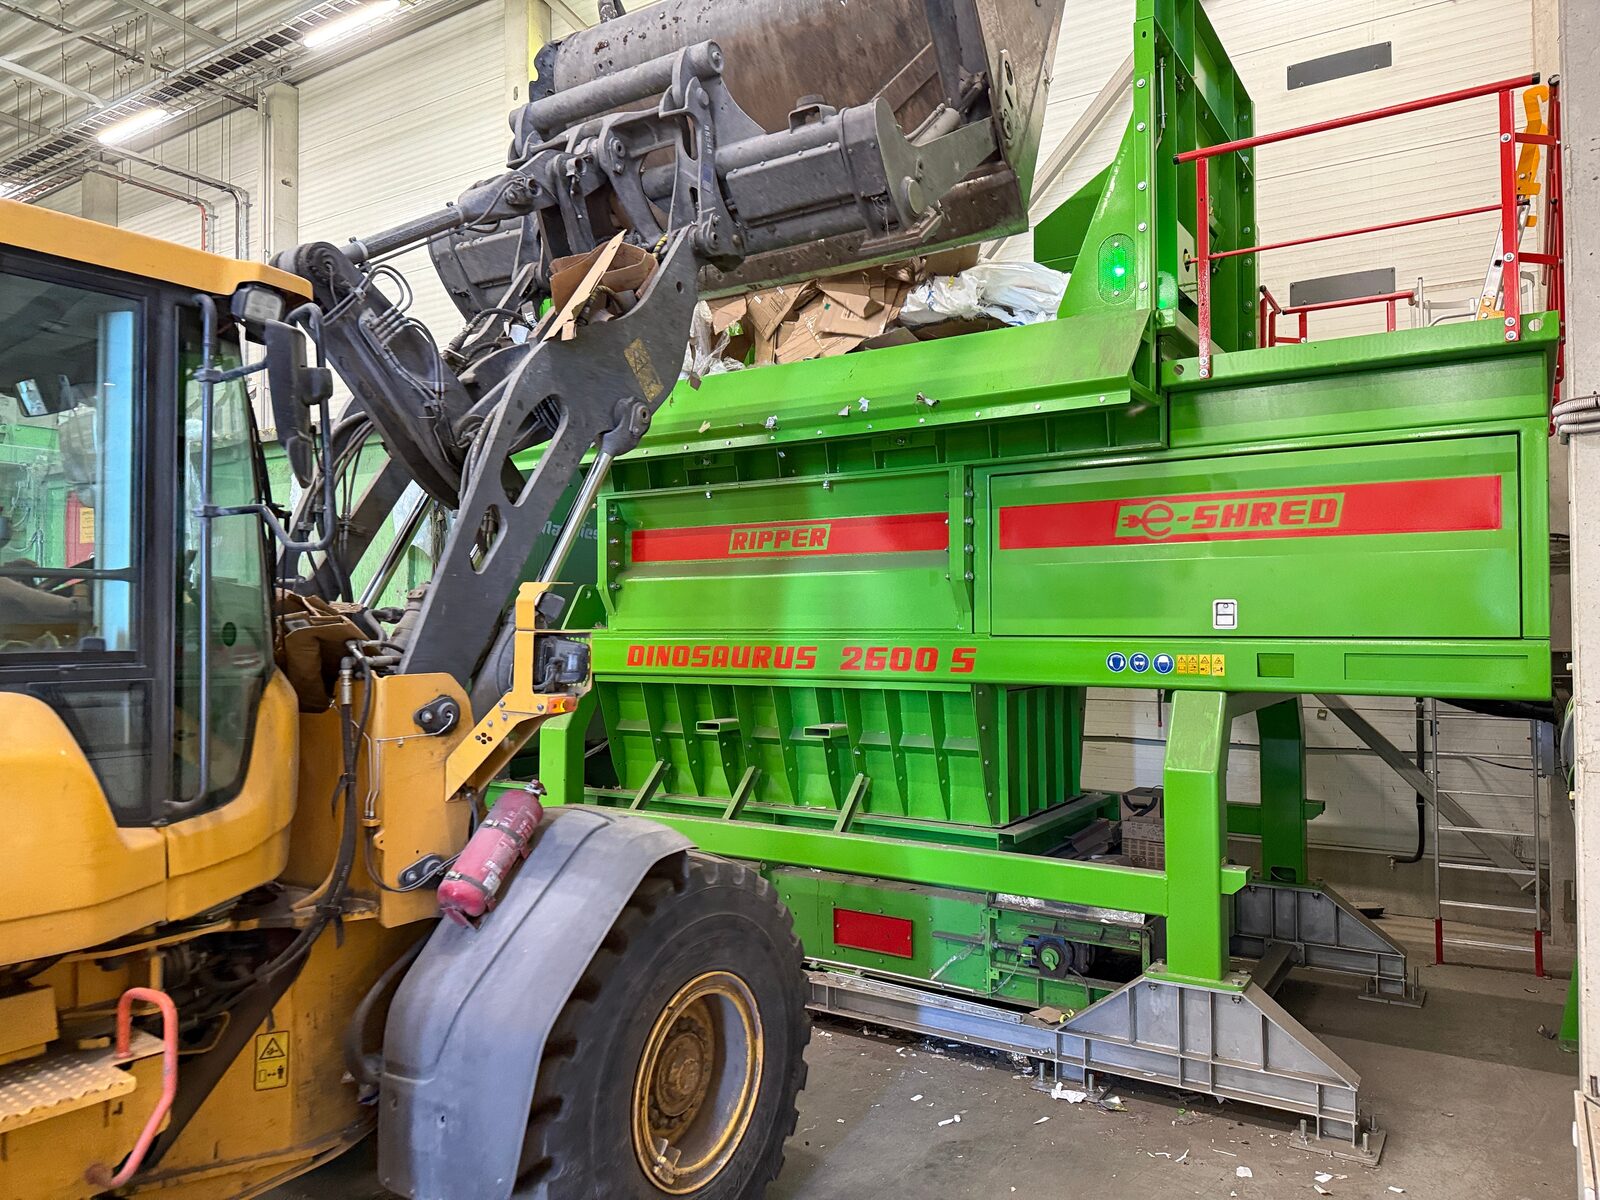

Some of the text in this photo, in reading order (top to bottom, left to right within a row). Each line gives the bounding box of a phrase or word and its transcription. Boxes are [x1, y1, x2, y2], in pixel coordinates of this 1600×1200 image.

[1141, 498, 1338, 536] e-SHRED
[732, 528, 827, 550] RIPPER
[626, 645, 977, 673] DINOSAURUS 2600 S
